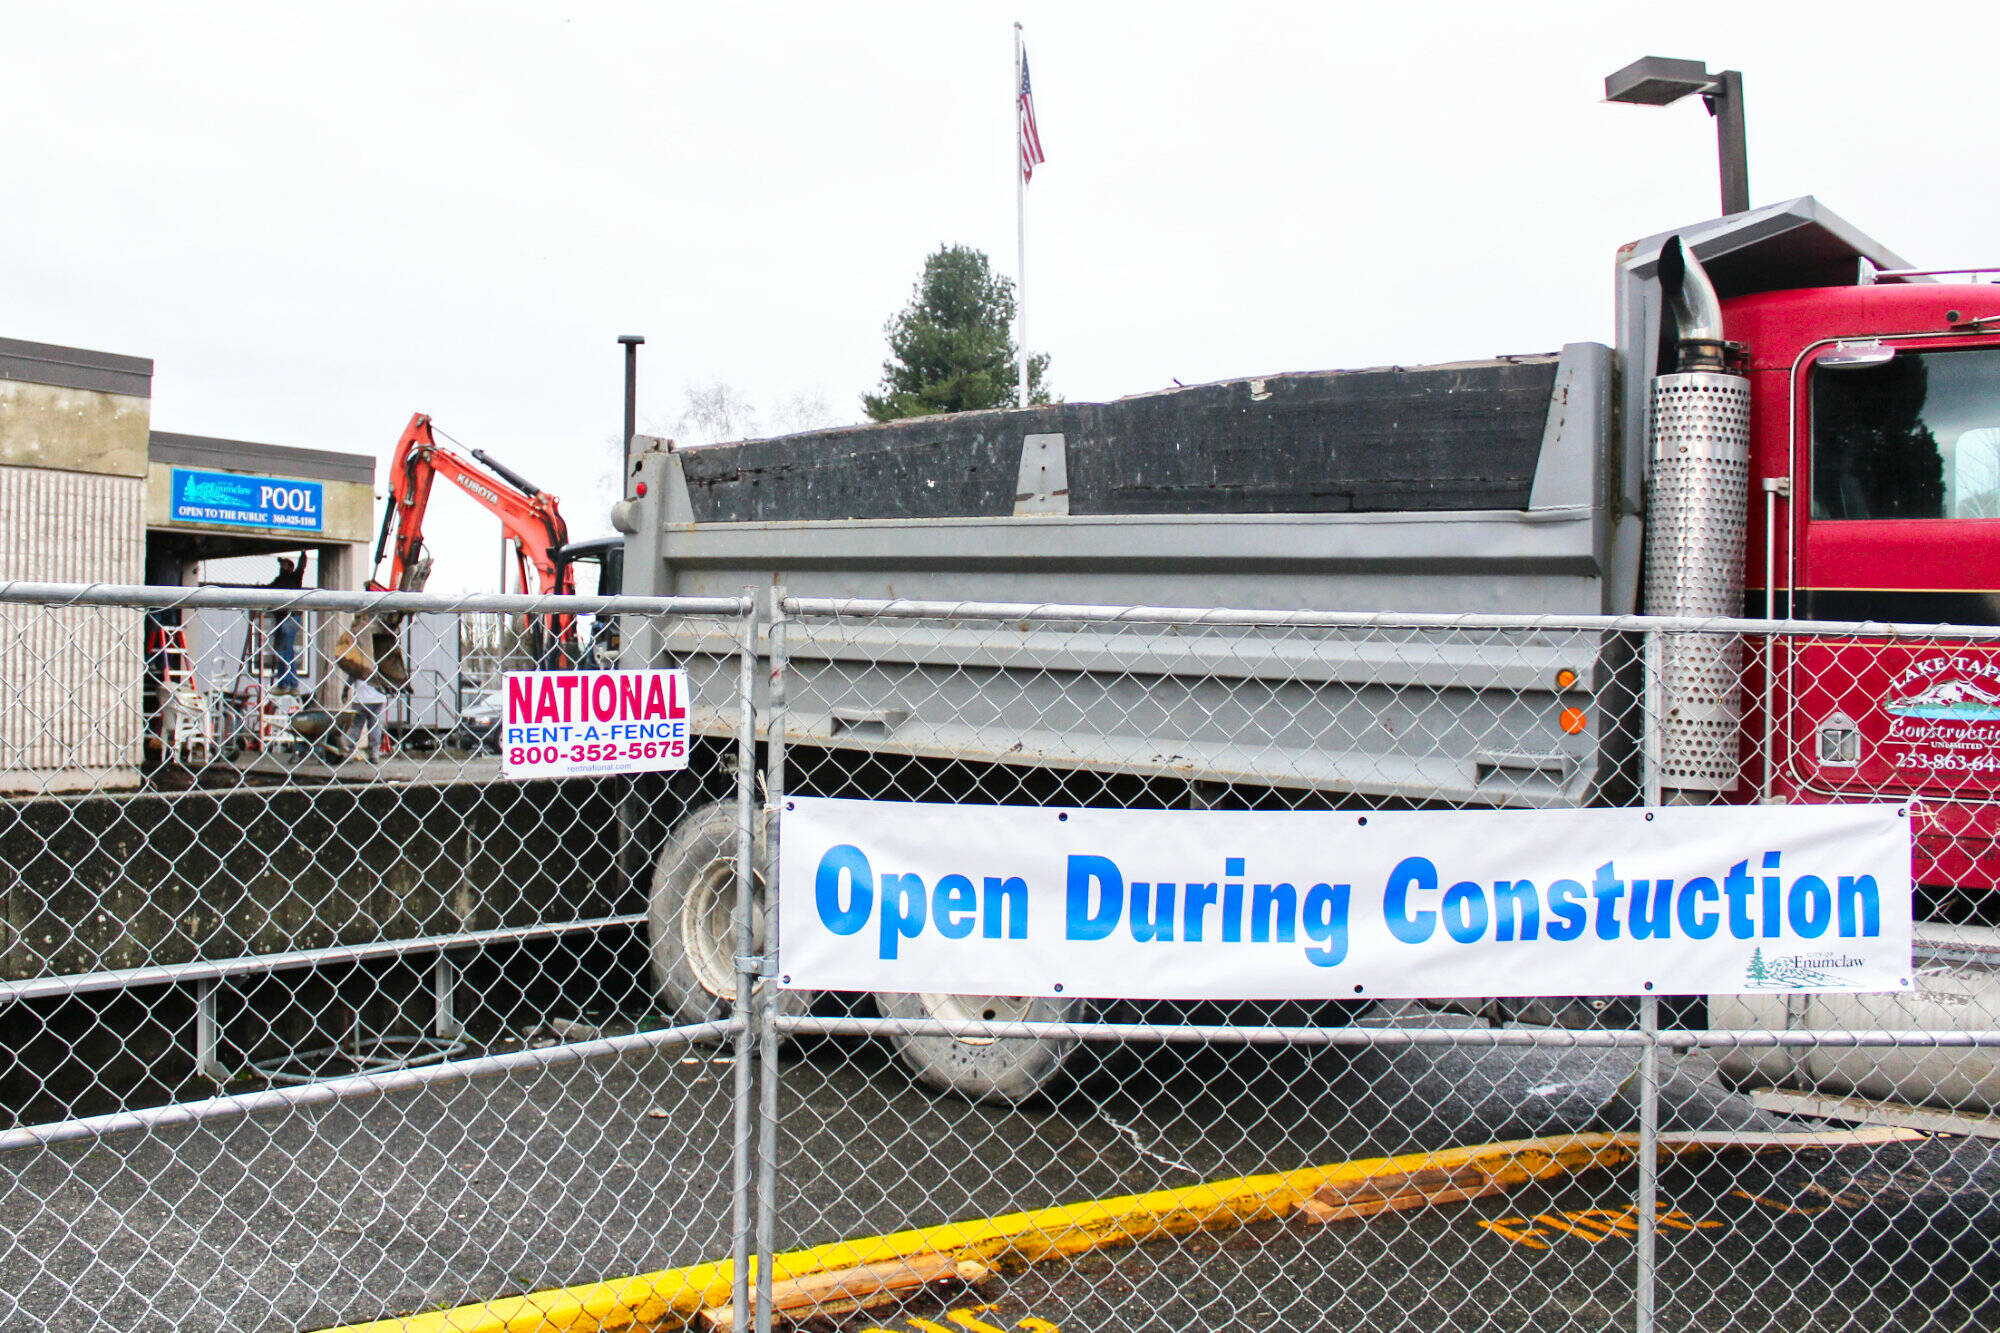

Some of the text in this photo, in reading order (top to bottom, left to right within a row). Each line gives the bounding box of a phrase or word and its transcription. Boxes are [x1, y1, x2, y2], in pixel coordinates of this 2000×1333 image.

[260, 486, 316, 513] POOL
[456, 473, 498, 505] KUBOTA
[178, 506, 203, 517] OPEN
[204, 508, 217, 519] TO
[219, 509, 236, 520] THE
[237, 511, 267, 523] PUBLIC
[1889, 657, 1945, 690] LAKE
[509, 674, 686, 725] NATIONAL
[508, 723, 685, 744] RENT-A-FENCE
[1930, 741, 1983, 750] UNLIMITED
[509, 740, 685, 766] 800-352-5675
[567, 763, 632, 773] rentnational.com
[815, 844, 1881, 968] Open During Constuction
[1794, 954, 1865, 969] Enumclaw
